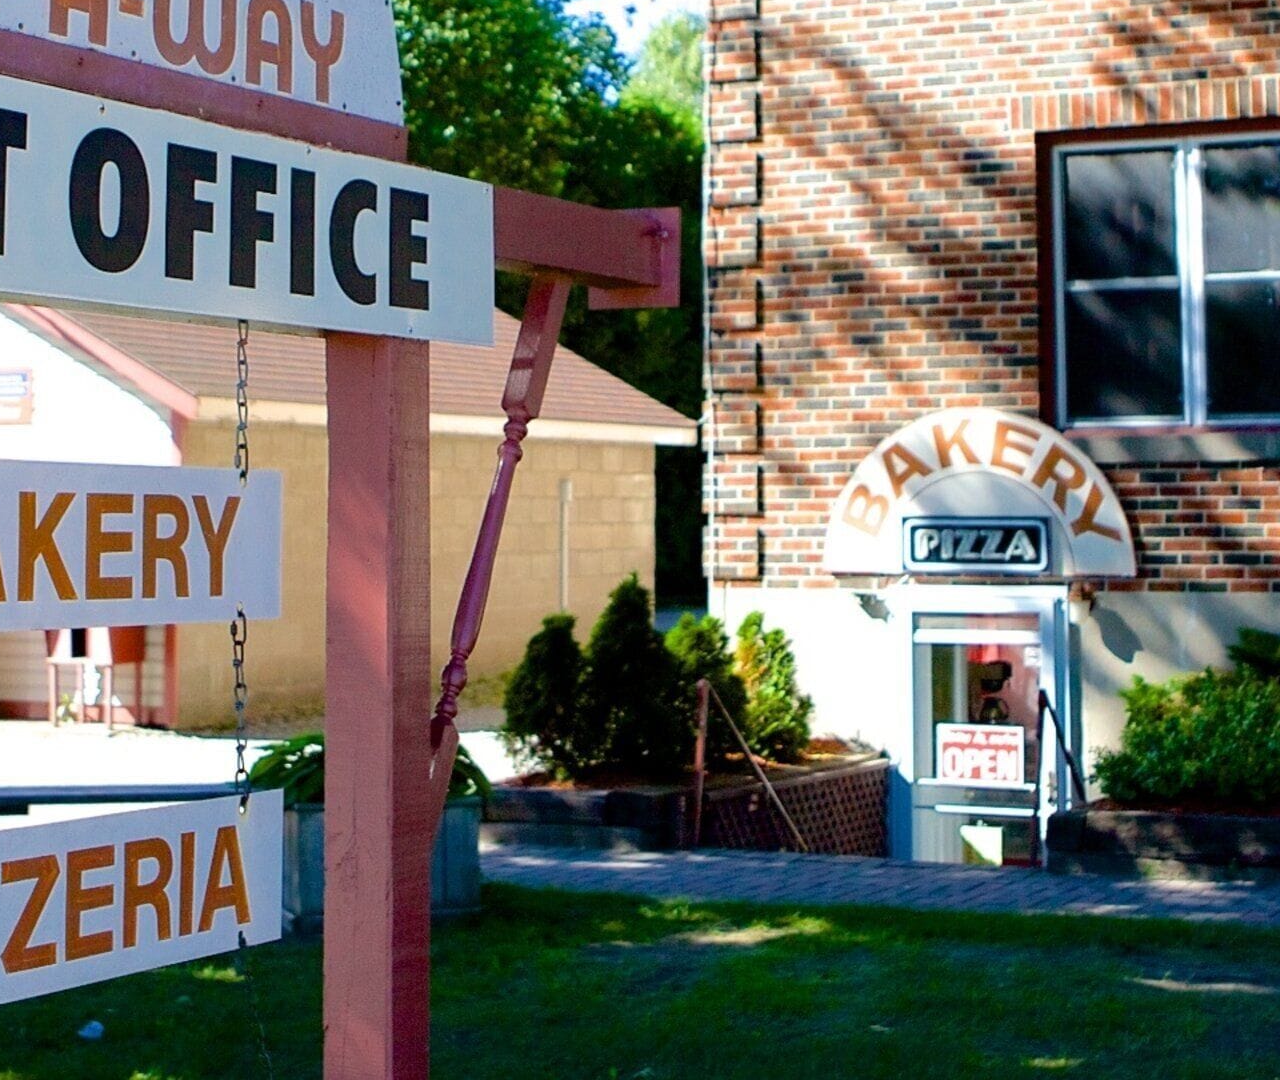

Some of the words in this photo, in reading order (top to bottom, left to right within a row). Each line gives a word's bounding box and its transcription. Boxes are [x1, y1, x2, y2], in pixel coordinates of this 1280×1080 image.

[68, 126, 431, 311] OFFICE
[844, 419, 1122, 541] BAKERY
[914, 528, 1037, 562] PIZZA
[943, 747, 1020, 781] OPEN
